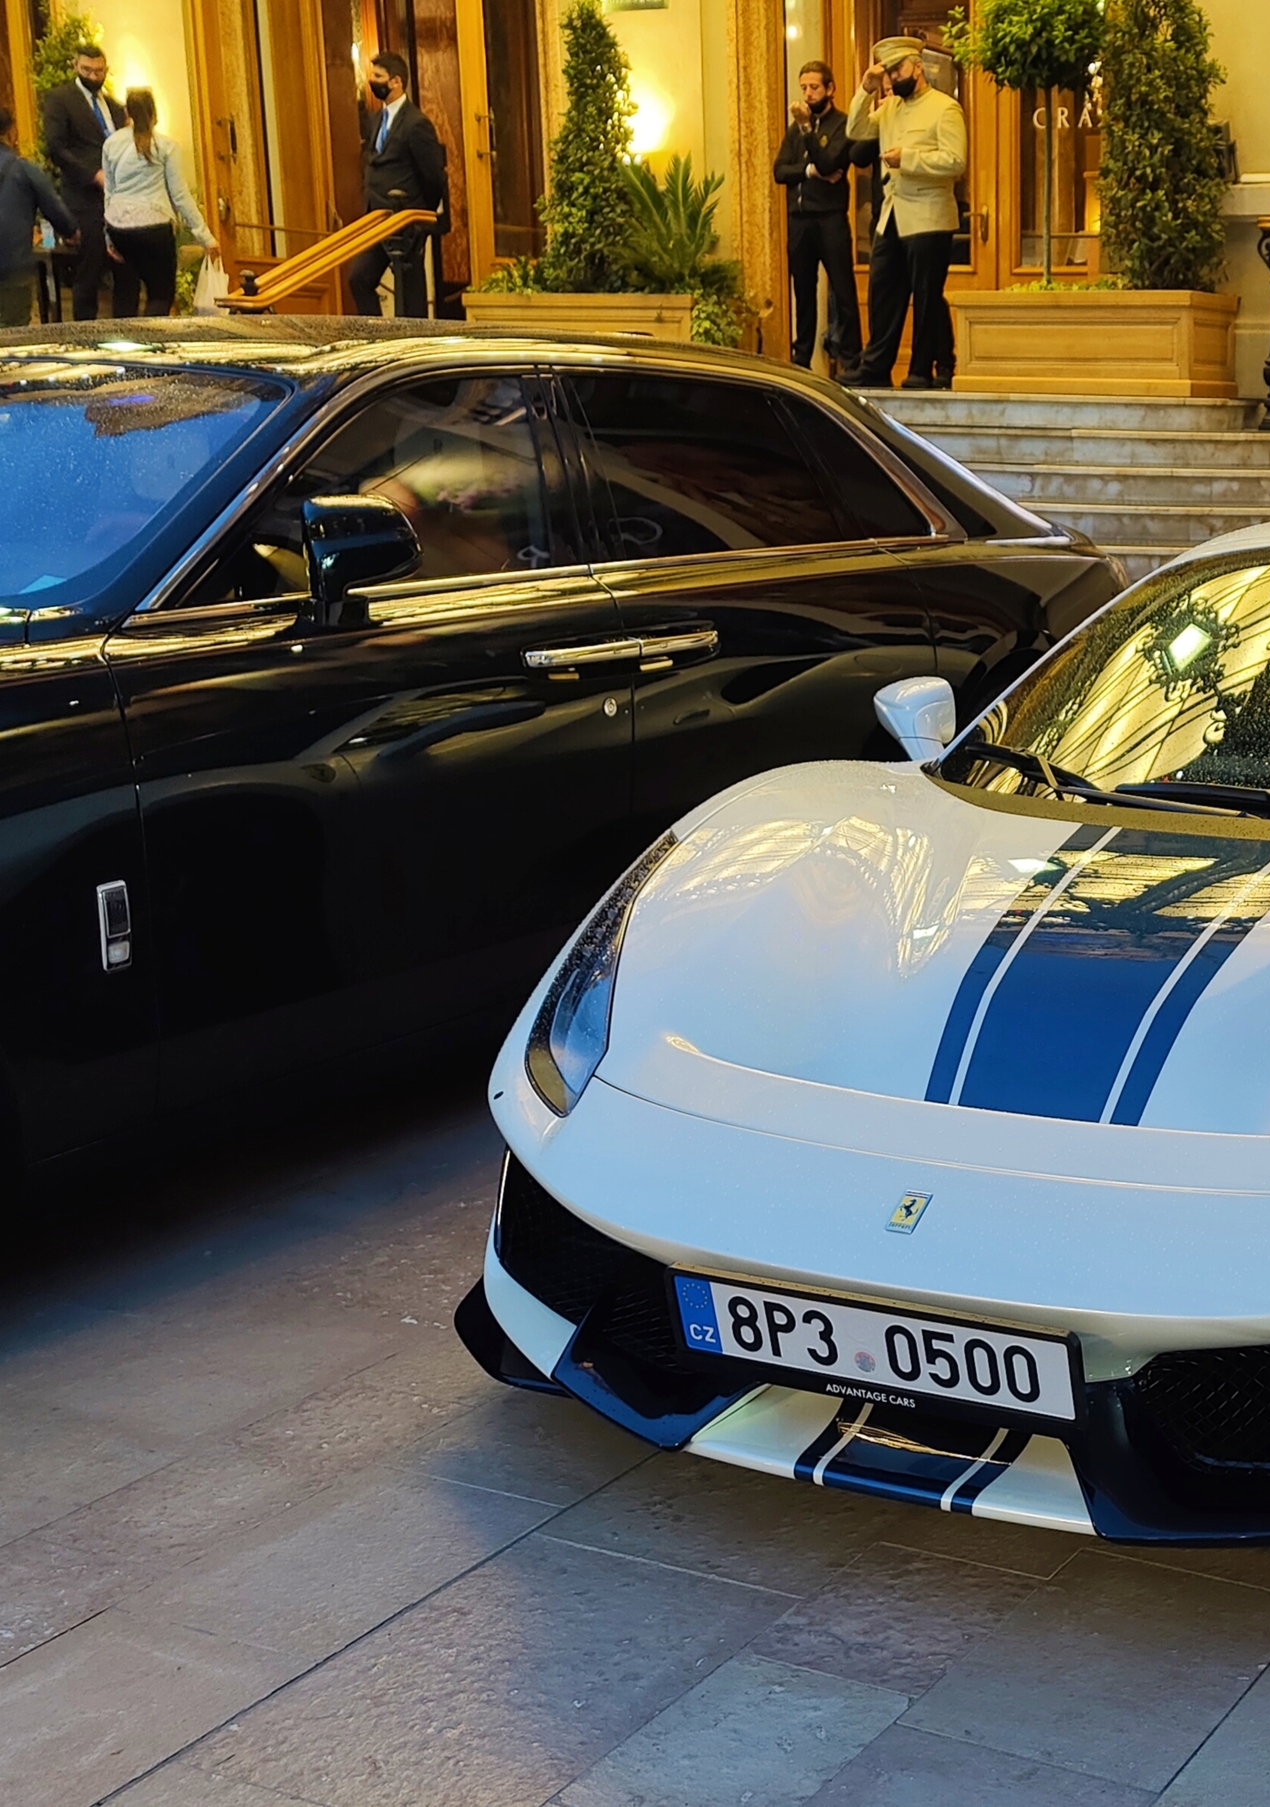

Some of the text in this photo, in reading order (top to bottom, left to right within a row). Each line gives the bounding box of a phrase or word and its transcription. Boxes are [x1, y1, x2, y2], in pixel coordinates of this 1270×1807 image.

[689, 1324, 716, 1343] CZ
[728, 1296, 1040, 1402] 8P3 0500
[825, 1383, 916, 1408] ADVANTAGE CARS
